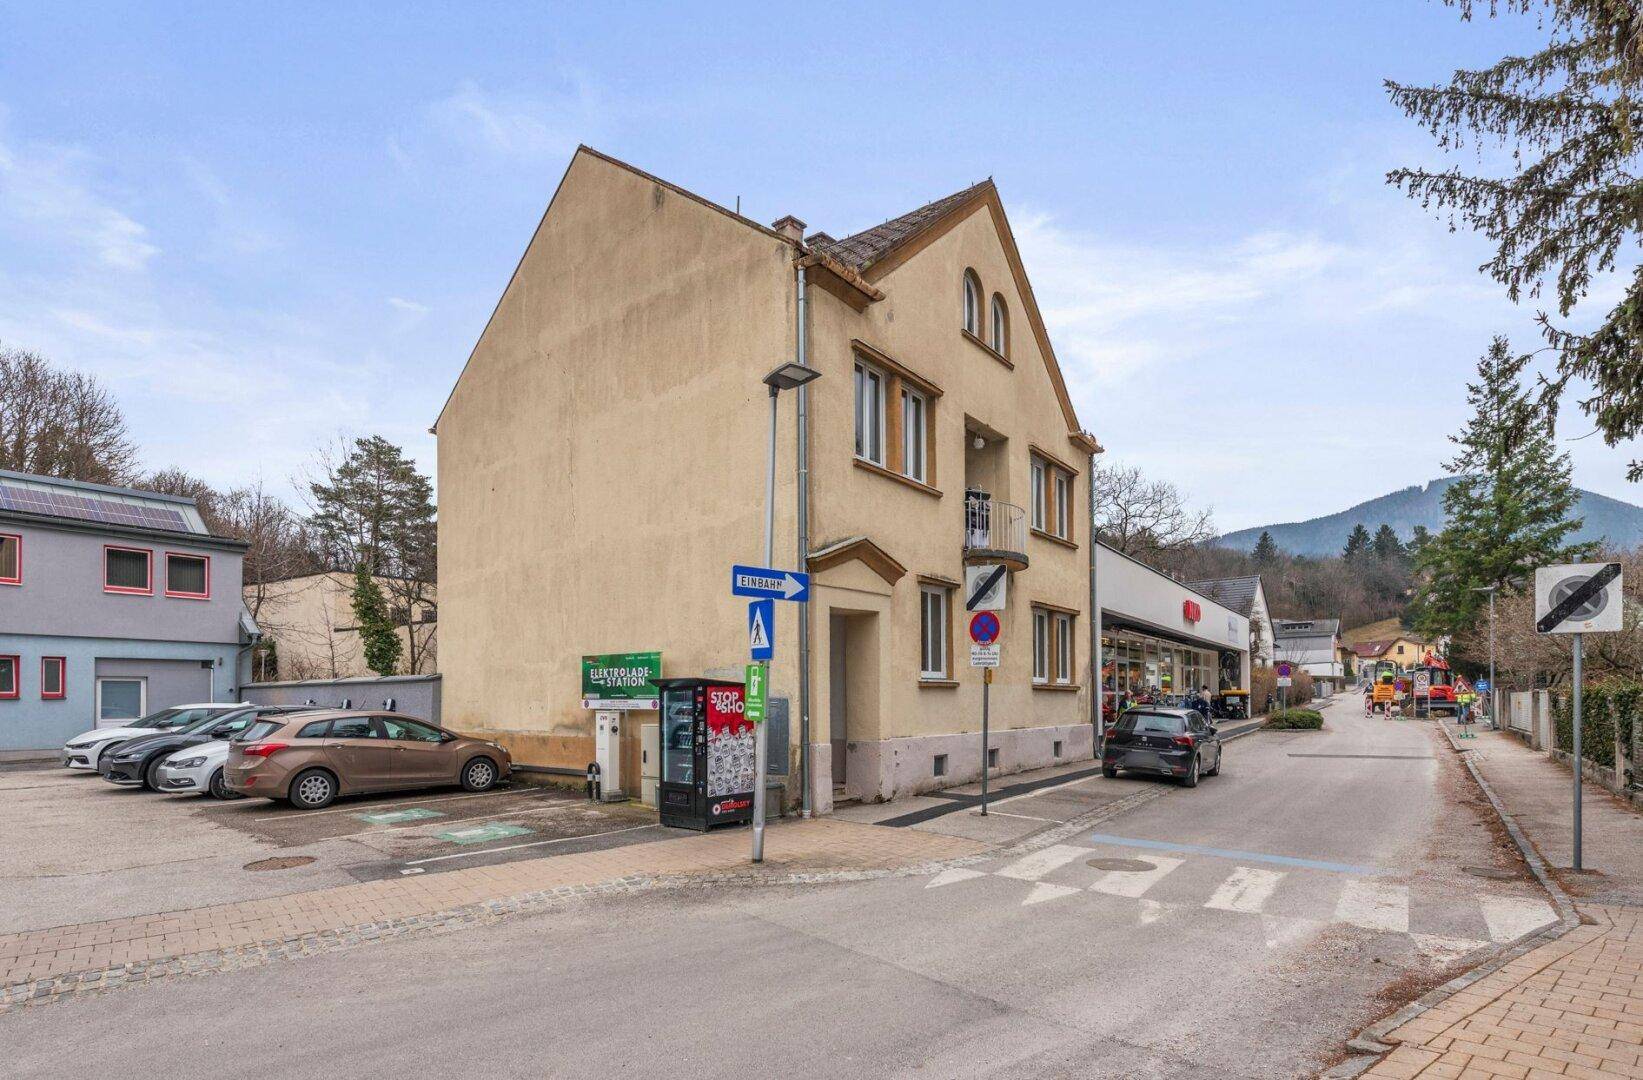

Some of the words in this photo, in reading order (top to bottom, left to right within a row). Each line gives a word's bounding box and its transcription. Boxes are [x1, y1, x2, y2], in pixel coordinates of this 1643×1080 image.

[741, 576, 782, 589] EINBAHN
[590, 667, 652, 678] ELEKTROLADE-
[607, 677, 645, 687] STATION
[711, 691, 739, 704] STOP
[715, 701, 745, 713] &SHO
